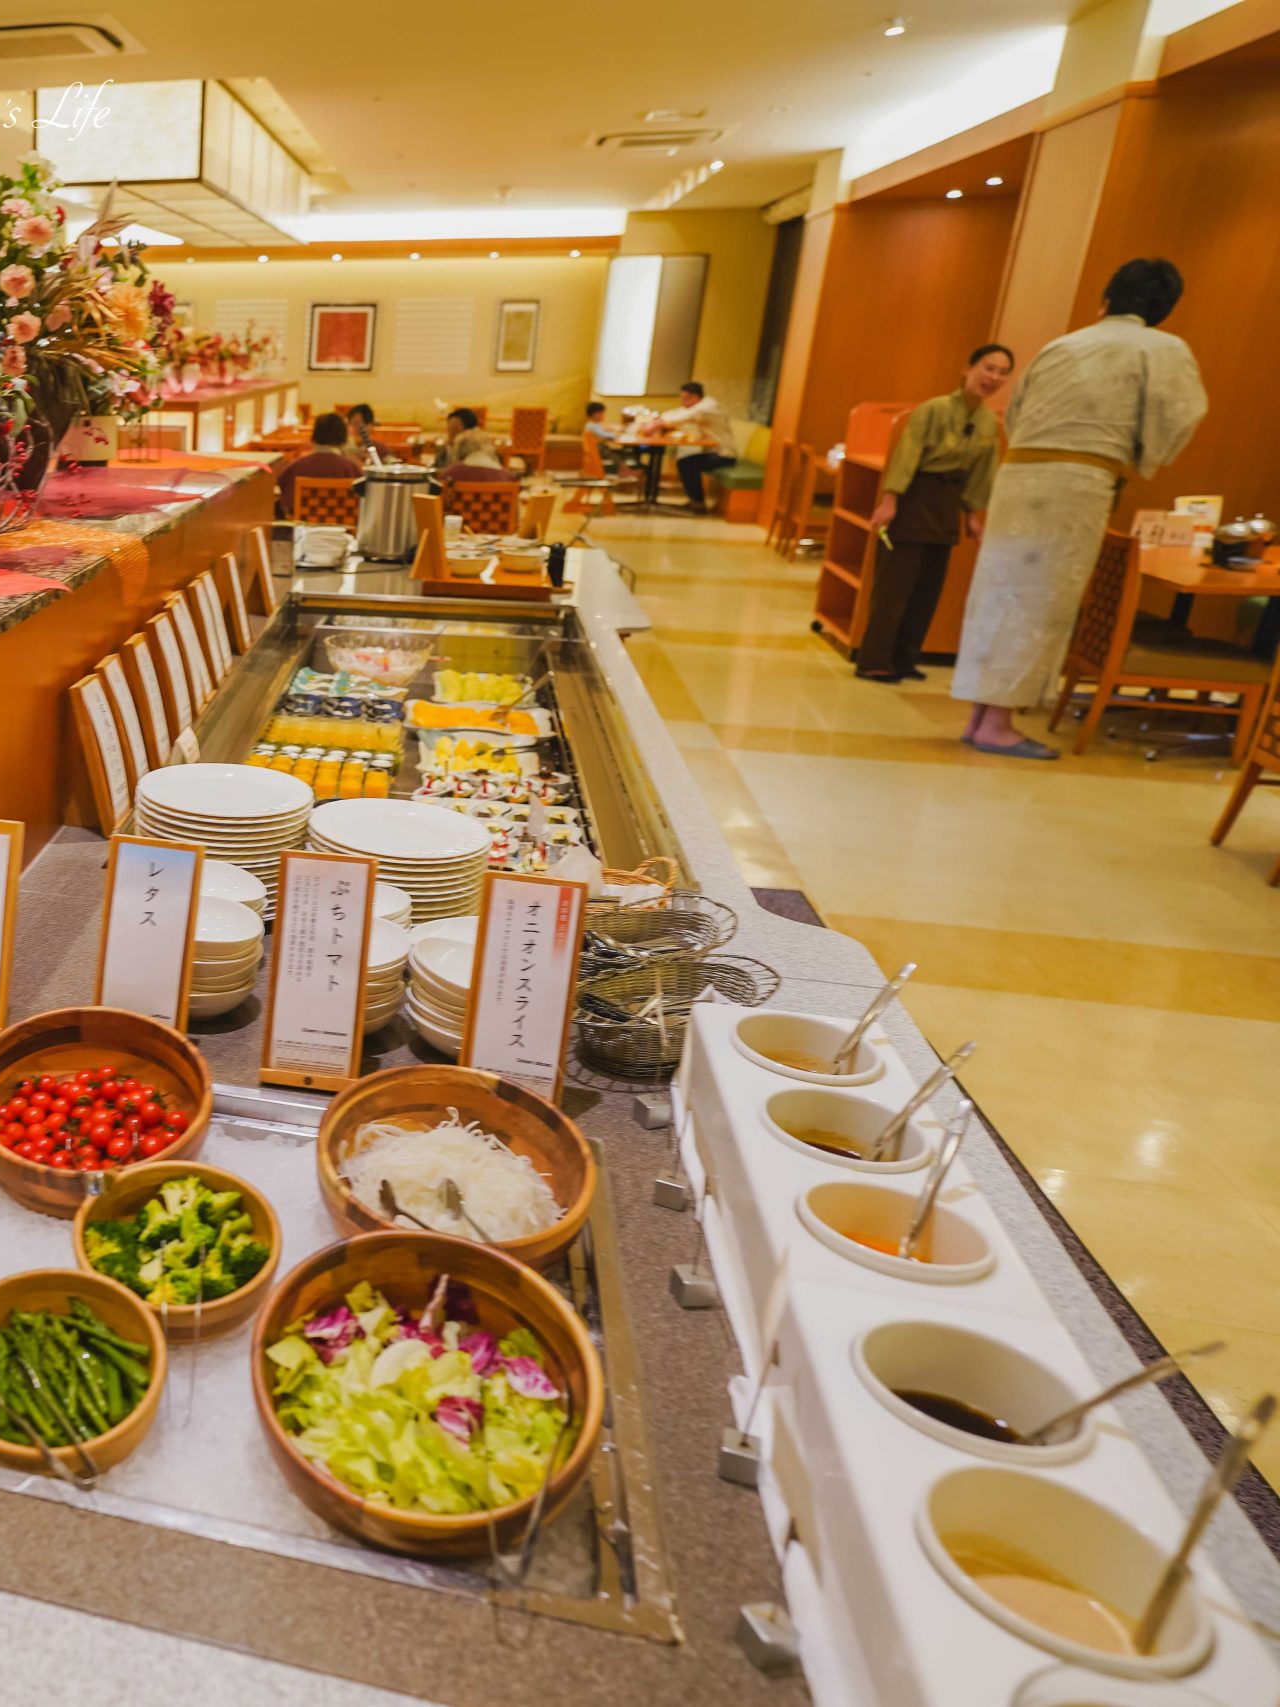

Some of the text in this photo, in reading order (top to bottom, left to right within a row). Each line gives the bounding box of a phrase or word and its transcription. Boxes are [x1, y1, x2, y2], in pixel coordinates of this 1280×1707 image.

[136, 862, 164, 927] レタス
[507, 901, 542, 1049] オニオンスライス
